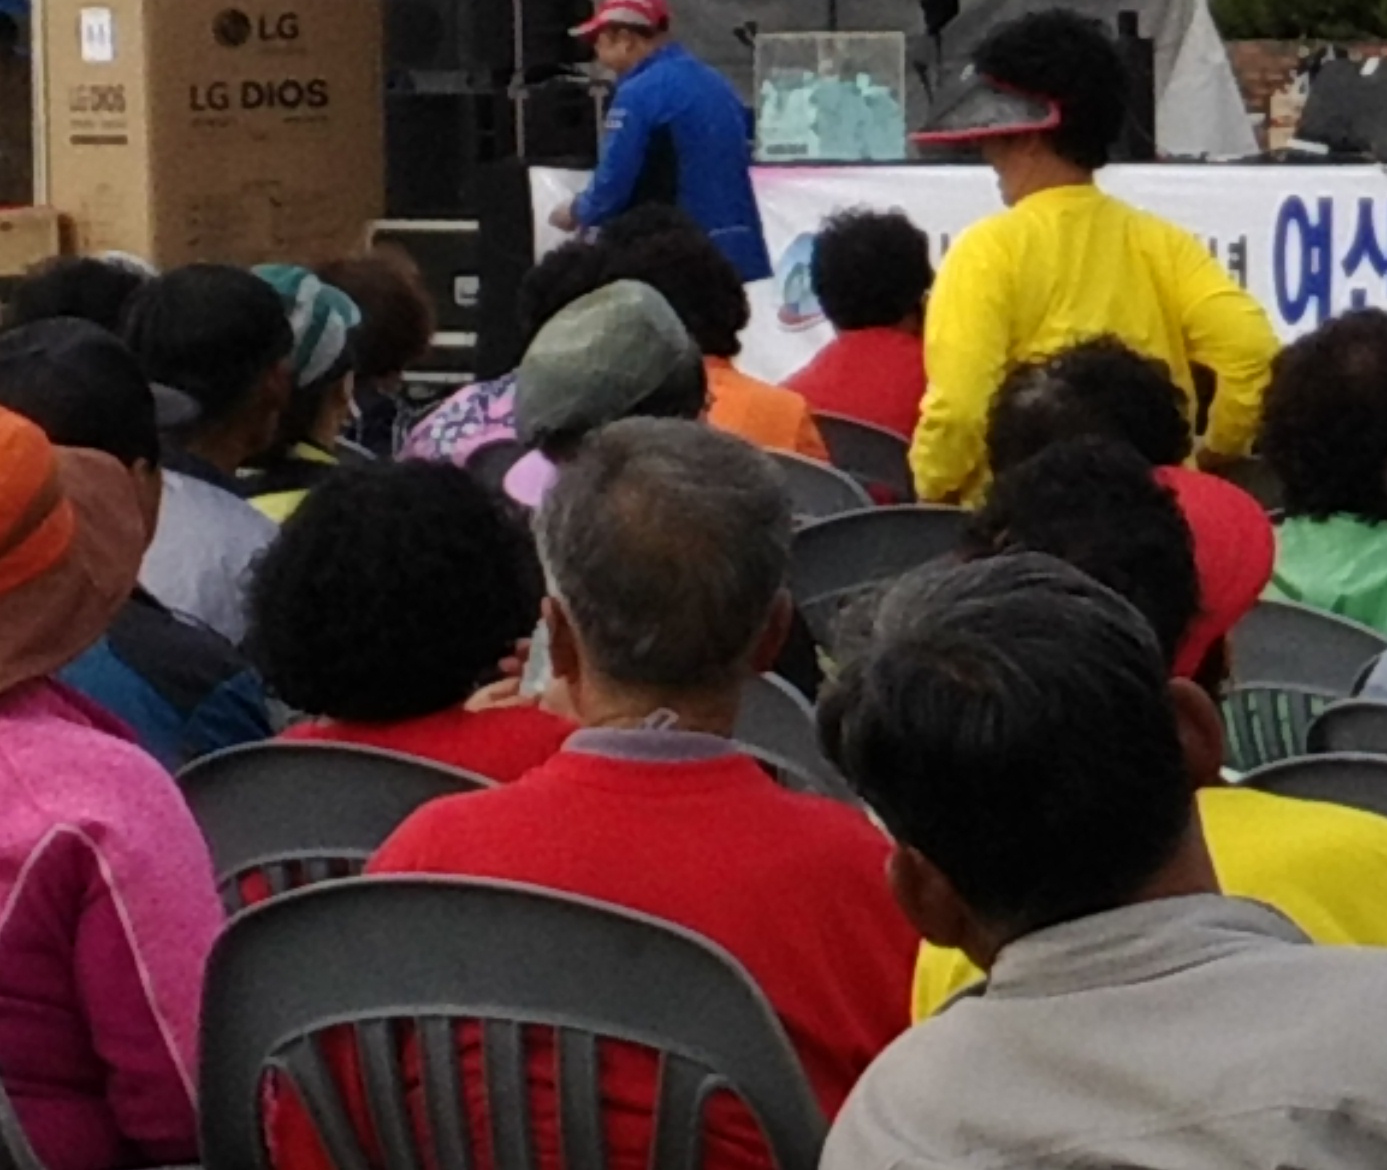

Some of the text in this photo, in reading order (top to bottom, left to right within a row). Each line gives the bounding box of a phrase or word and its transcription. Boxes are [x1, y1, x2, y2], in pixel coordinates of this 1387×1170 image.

[258, 11, 301, 42] LG
[189, 78, 330, 112] LG DIOS
